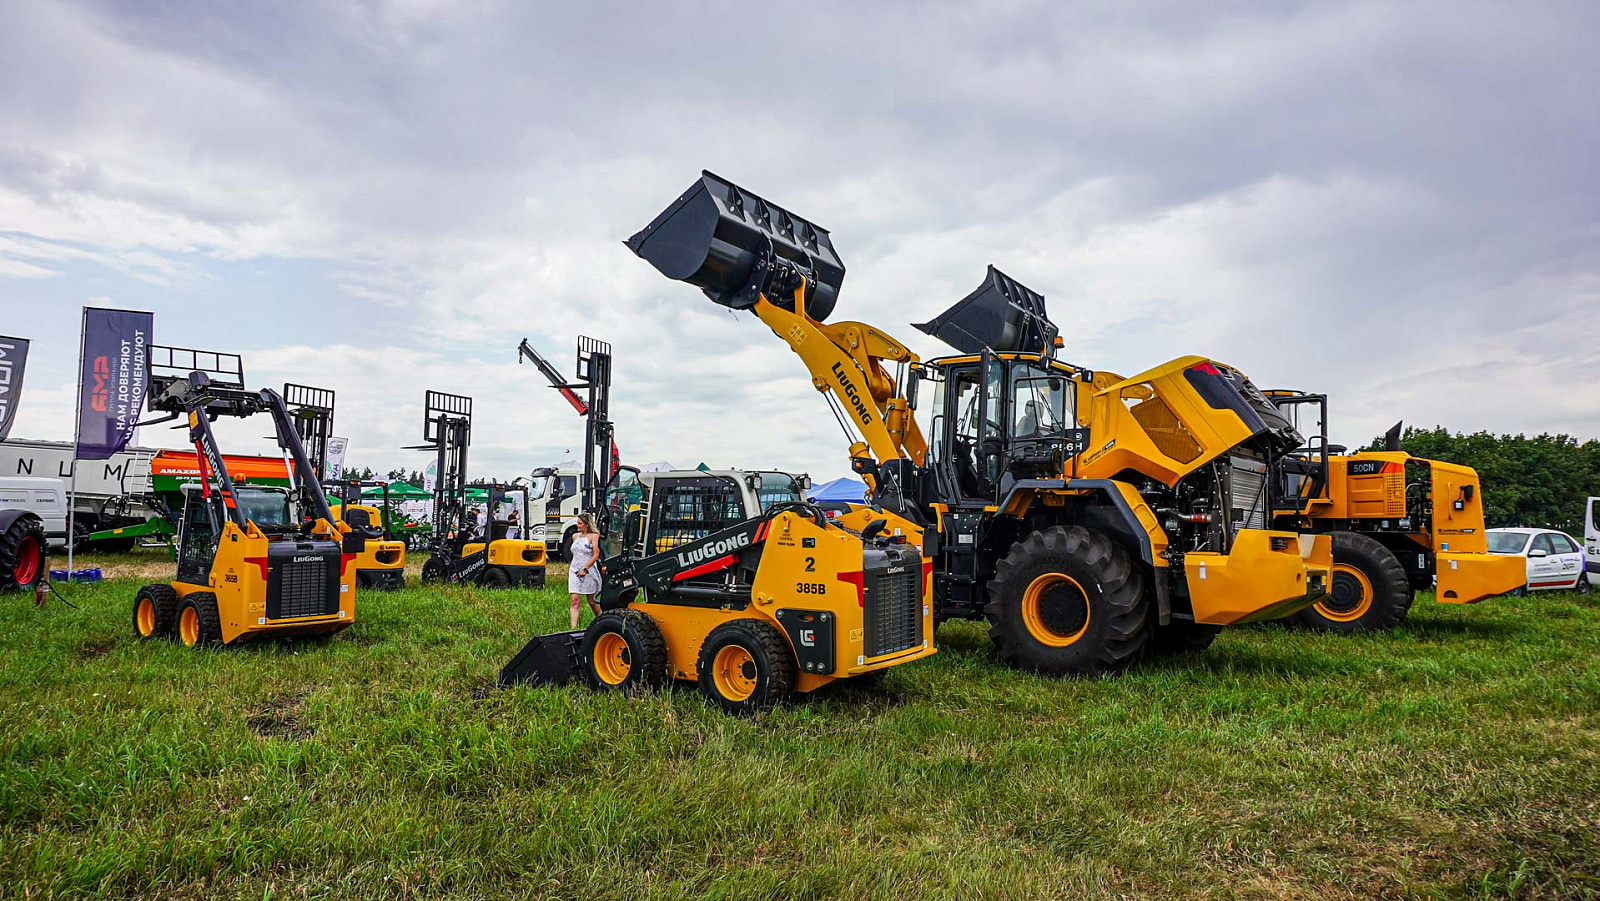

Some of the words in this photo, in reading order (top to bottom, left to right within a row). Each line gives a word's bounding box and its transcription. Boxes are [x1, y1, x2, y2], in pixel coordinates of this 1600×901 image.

[118, 339, 131, 403] ДОВЕРЯЮТ
[130, 329, 145, 416] РЕКОМЕНДУЮТ
[116, 404, 127, 431] НАМ
[1353, 463, 1375, 473] 50CN
[489, 549, 496, 557] 30
[804, 556, 816, 572] 2
[224, 573, 238, 583] 365B
[796, 582, 826, 595] 385B
